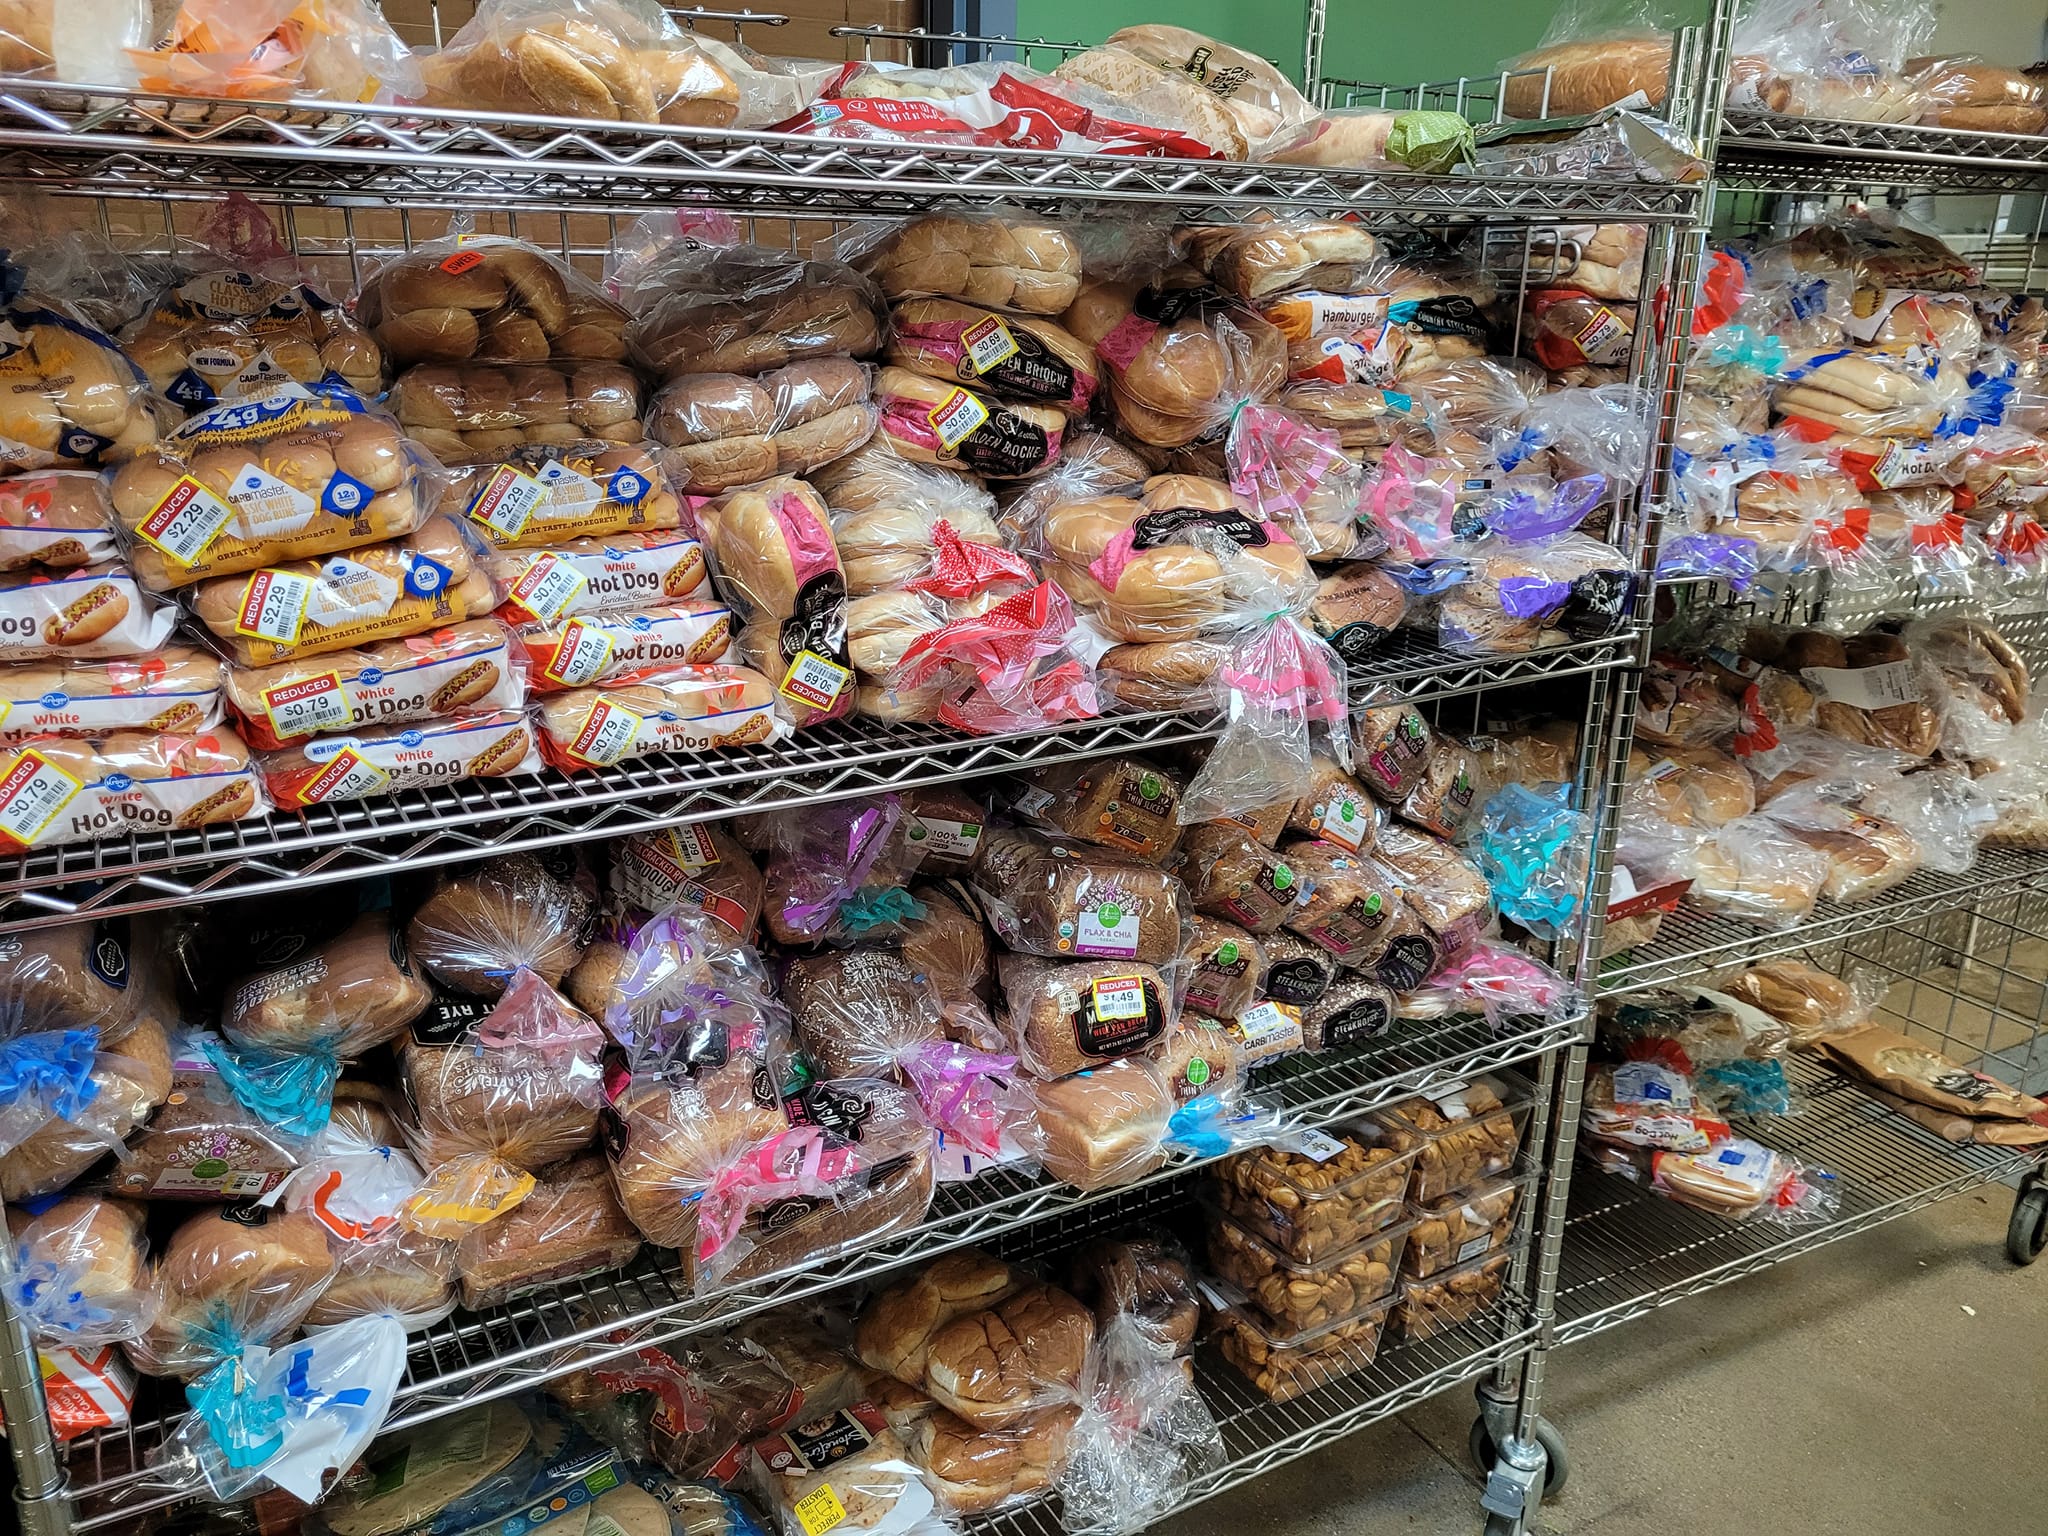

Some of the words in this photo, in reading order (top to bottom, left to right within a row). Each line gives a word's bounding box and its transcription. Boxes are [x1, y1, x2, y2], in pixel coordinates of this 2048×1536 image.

[448, 254, 480, 271] SWEET
[1322, 309, 1375, 326] Hamburger
[969, 321, 995, 342] REDUCED
[1587, 324, 1611, 345] $0.79
[978, 333, 1001, 352] $0.69
[966, 359, 973, 370] 8
[1026, 362, 1068, 389] BRIOCHE
[176, 381, 202, 400] 4g
[211, 406, 259, 428] 4g
[936, 393, 964, 422] REDUCED
[945, 405, 971, 430] $0.69
[265, 496, 296, 510] WHITE
[337, 490, 355, 500] 12g
[481, 473, 511, 514] REDUCED
[497, 487, 524, 519] $2.29
[149, 486, 191, 532] REDUCED
[167, 503, 204, 538] $2.29
[522, 526, 540, 536] REAT
[543, 523, 570, 533] TASTE,
[571, 520, 583, 528] NO
[585, 516, 618, 526] REGRETS
[217, 549, 248, 561] GREAT
[279, 534, 293, 545] NO
[295, 527, 336, 543] REGRETS
[493, 531, 500, 539] 8
[419, 572, 434, 581] 12g
[519, 557, 551, 595] REDUCED
[604, 561, 636, 573] White
[352, 580, 380, 594] WHITE
[533, 571, 562, 602] $0.79
[587, 576, 619, 595] Hot
[625, 572, 658, 591] Dog
[245, 576, 268, 626] REDUCED
[262, 585, 286, 625] $2.29
[359, 592, 383, 605] BUNS
[600, 591, 632, 606] Enriched
[301, 635, 333, 648] GREAT
[334, 628, 364, 641] TASTE,
[365, 622, 379, 632] NO
[381, 612, 420, 629] REGRETS
[276, 642, 285, 653] 8
[555, 627, 579, 673] REDUCED
[569, 640, 592, 675] $0.79
[611, 646, 644, 662] Hot
[649, 644, 685, 660] Dog
[273, 679, 330, 702] REDUCED
[355, 686, 395, 700] White
[804, 672, 832, 693] $0.69
[792, 683, 829, 705] REDUCED
[285, 696, 329, 716] $0.79
[353, 704, 375, 722] ot
[380, 695, 425, 715] Dog
[33, 712, 80, 725] White
[577, 707, 605, 751] REDUCED
[592, 720, 618, 754] $0.79
[656, 724, 686, 736] White
[312, 746, 326, 756] NEW
[673, 735, 709, 750] Dog
[395, 749, 433, 763] White
[309, 757, 351, 798] REDUCED
[418, 760, 461, 778] Dog
[327, 773, 361, 801] $0.79
[8, 778, 48, 818] $0.79
[1127, 793, 1142, 806] THIN
[1144, 801, 1165, 815] SLICED
[71, 805, 118, 833] Hot
[121, 803, 172, 827] Dog
[694, 825, 713, 859] REDUCED
[932, 830, 959, 841] 100%
[1118, 827, 1130, 836] 70
[684, 829, 699, 856] $1.99
[641, 847, 677, 877] CRACKED
[1084, 928, 1105, 937] FLAX
[249, 979, 304, 1008] CRAFTED
[1100, 980, 1136, 991] REDUCED
[1104, 991, 1134, 1002] $1.49
[439, 1004, 474, 1020] RYE
[1244, 1006, 1269, 1020] $2.29
[1244, 1025, 1297, 1050] CARBmaster.
[1181, 1085, 1197, 1096] THIN
[802, 1430, 863, 1461] Stonefire
[799, 1487, 827, 1510] TOASTER
[804, 1507, 814, 1517] THE
[809, 1515, 820, 1525] FOR
[815, 1512, 841, 1534] PERFECT
